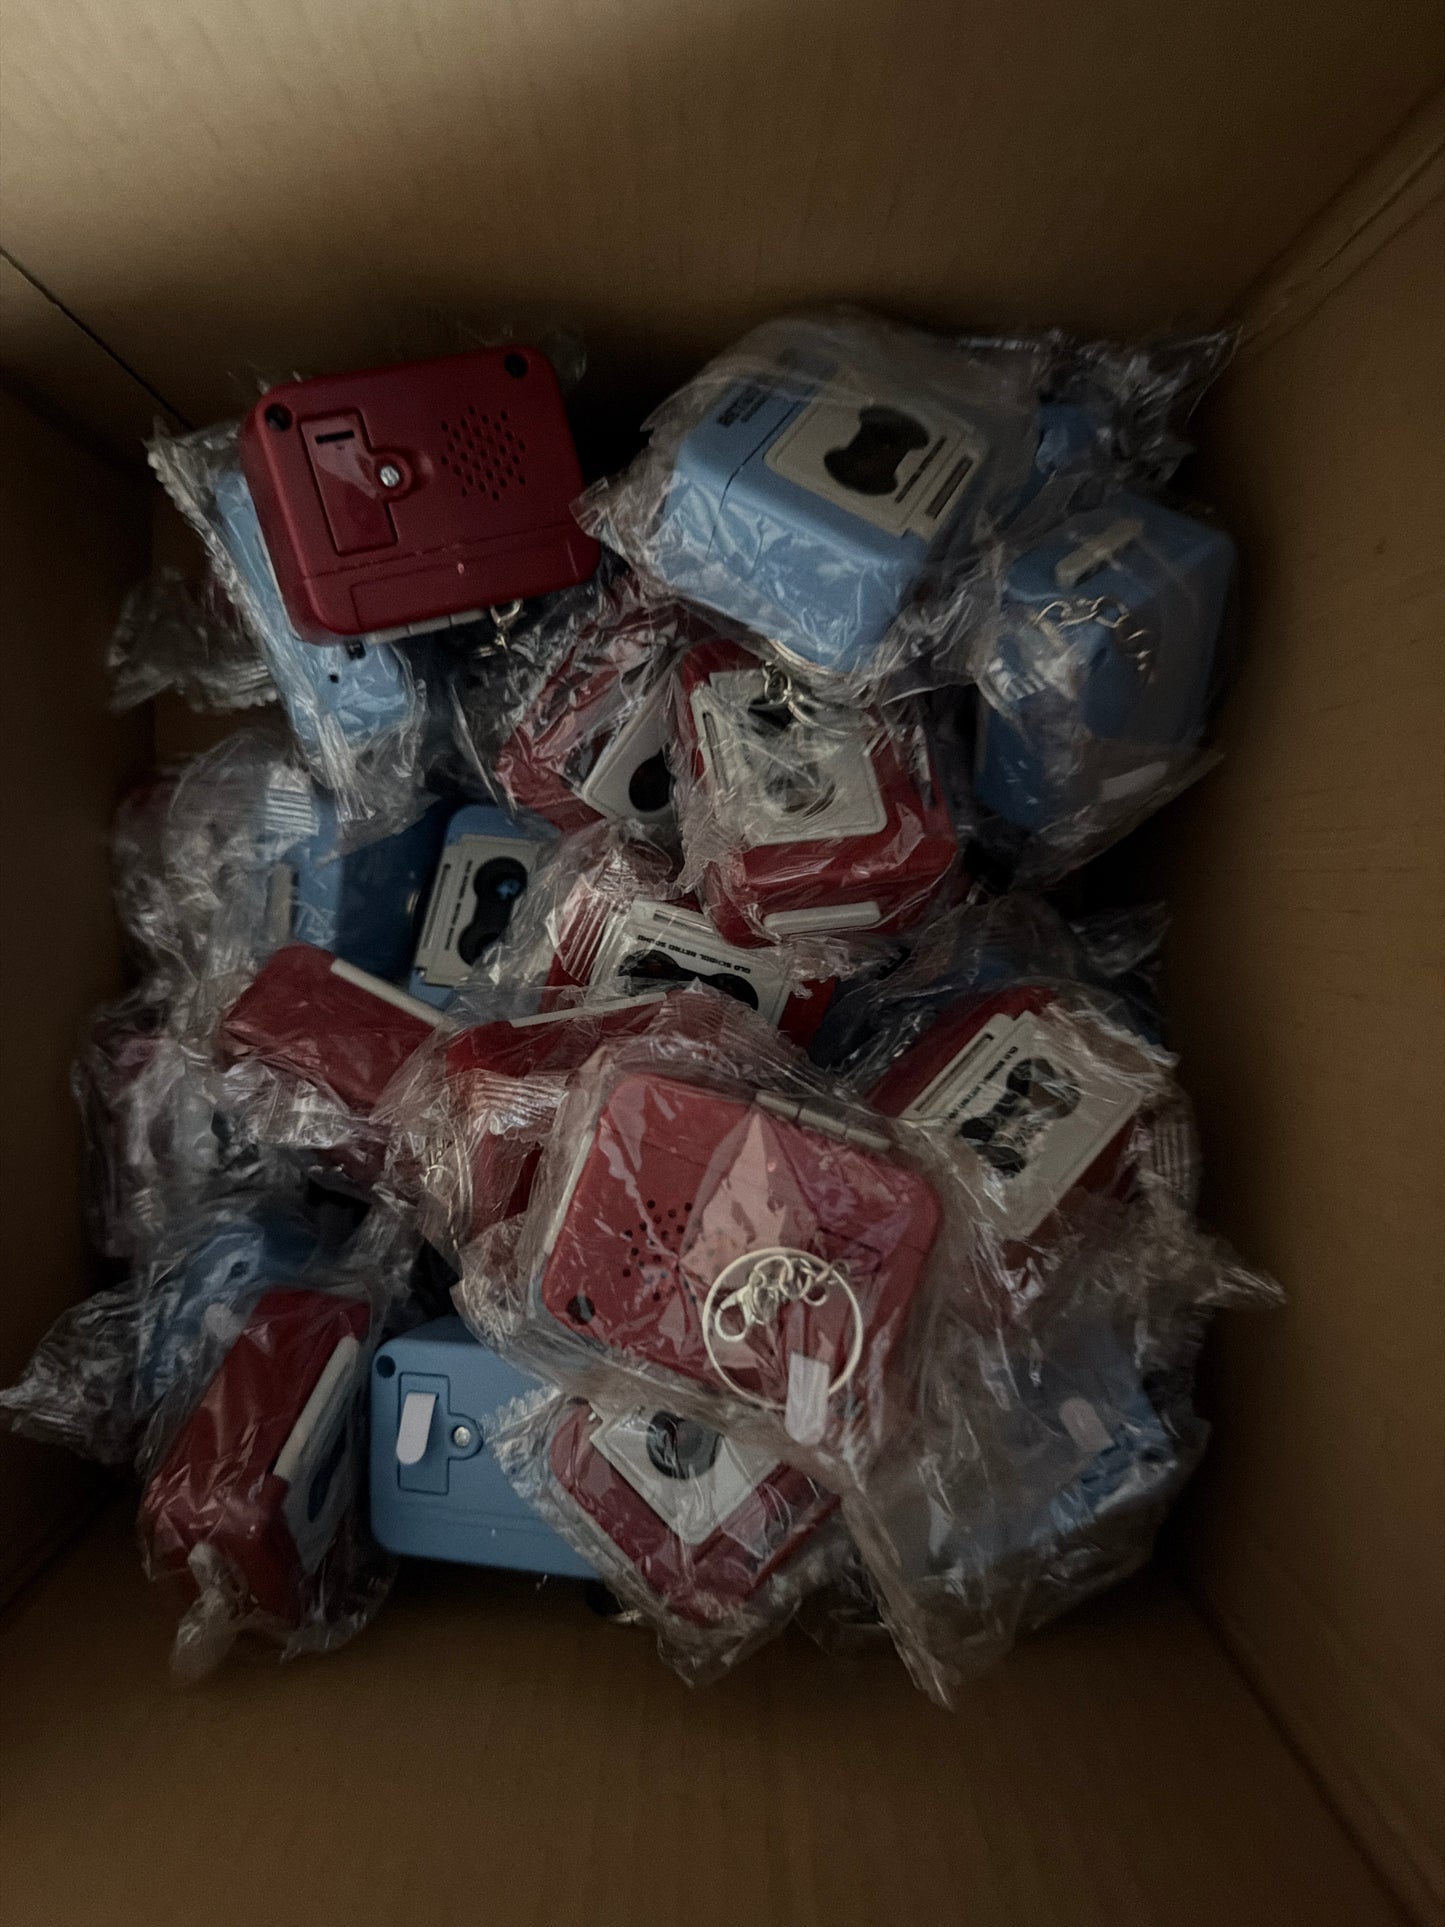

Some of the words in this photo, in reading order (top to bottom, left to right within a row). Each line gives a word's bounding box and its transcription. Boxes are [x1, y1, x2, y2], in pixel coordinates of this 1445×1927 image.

[668, 944, 697, 957] RETRO
[699, 954, 732, 968] SCHOOL
[734, 965, 751, 974] OLD
